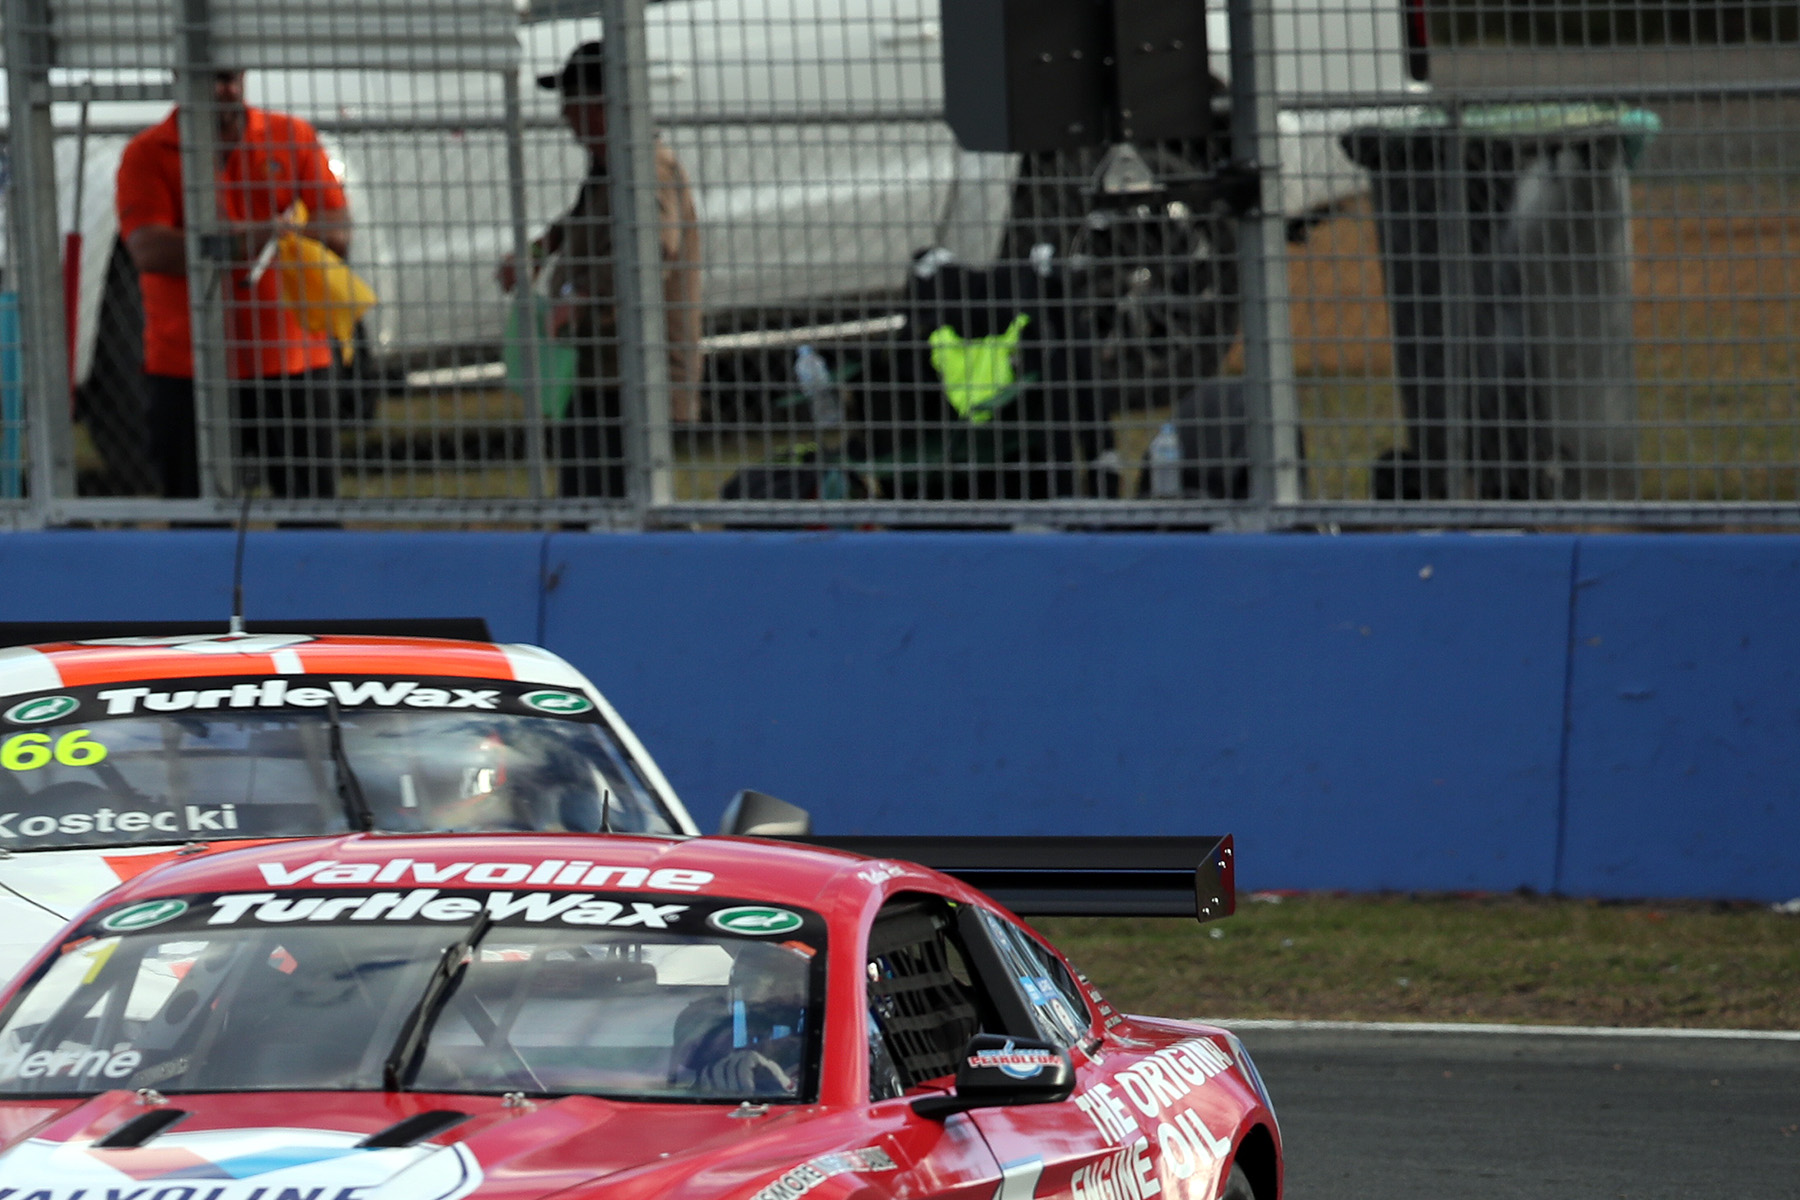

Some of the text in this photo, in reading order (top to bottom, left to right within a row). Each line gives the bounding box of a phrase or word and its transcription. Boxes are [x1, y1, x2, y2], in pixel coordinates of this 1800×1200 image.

[0, 730, 108, 771] 66
[257, 858, 716, 891] Valvoline
[82, 940, 121, 984] 1
[1074, 1036, 1235, 1147] THE ORIGINAL
[1156, 1108, 1231, 1179] OIL
